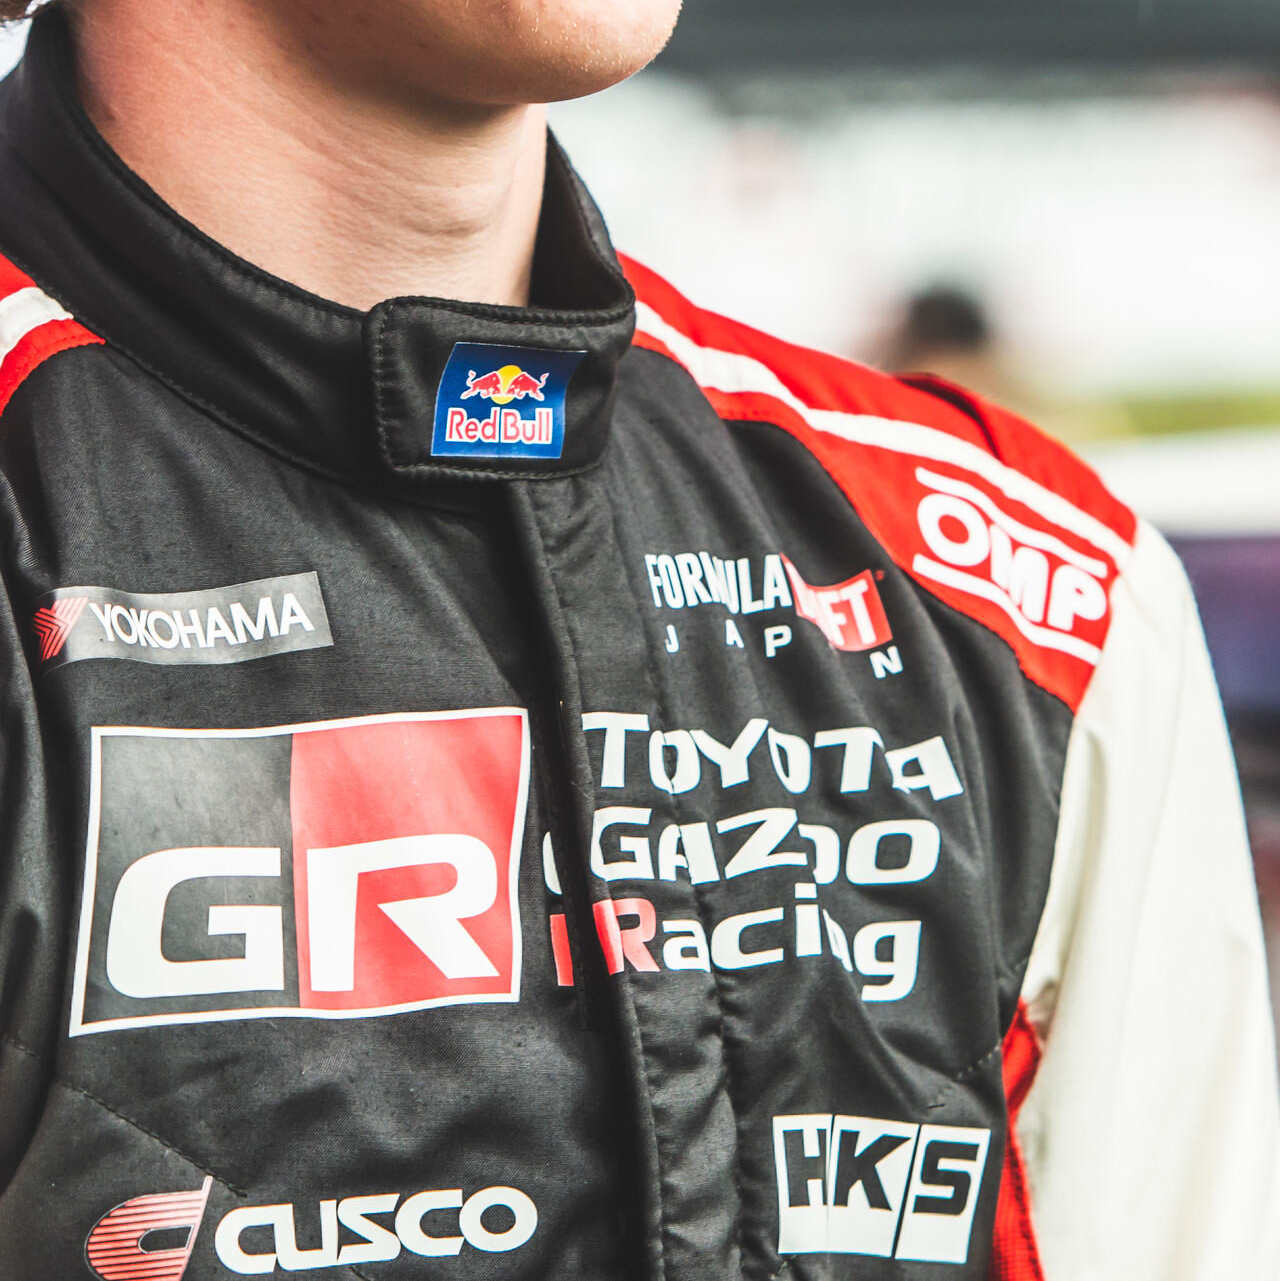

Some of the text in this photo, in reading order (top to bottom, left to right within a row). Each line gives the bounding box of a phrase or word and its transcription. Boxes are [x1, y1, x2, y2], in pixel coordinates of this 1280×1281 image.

[446, 407, 553, 443] Red Bull
[917, 492, 1109, 631] OMP
[90, 592, 315, 650] YOKOHAMA
[581, 711, 964, 800] TOYOTA
[106, 832, 500, 999] GR
[783, 1128, 980, 1217] HKS
[215, 1185, 538, 1275] CUSCO
